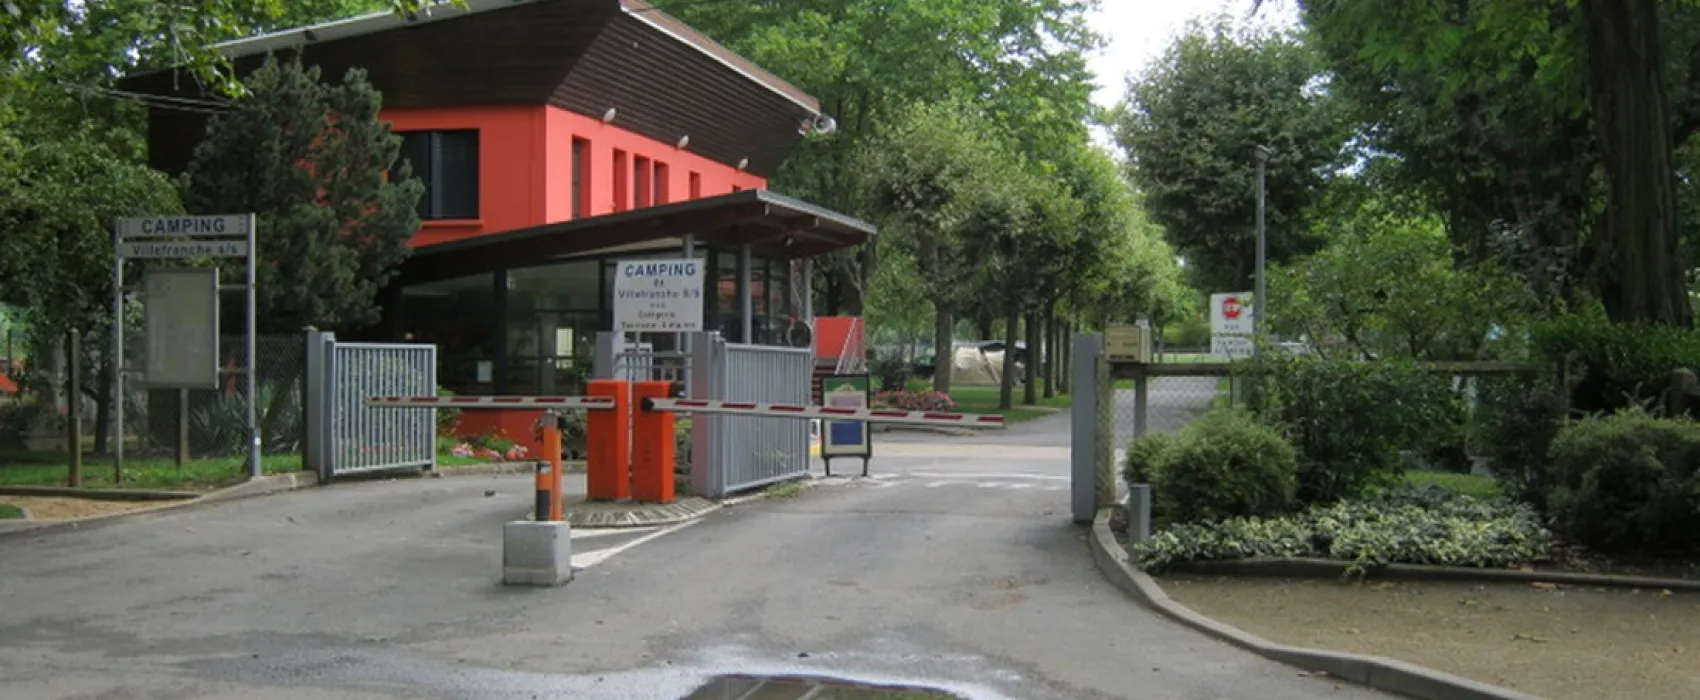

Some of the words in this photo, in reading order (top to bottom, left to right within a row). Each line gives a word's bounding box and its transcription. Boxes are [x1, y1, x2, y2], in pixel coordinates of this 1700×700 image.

[141, 217, 225, 233] CAMPING
[133, 244, 212, 257] Villefranche
[625, 263, 696, 277] CAMPING
